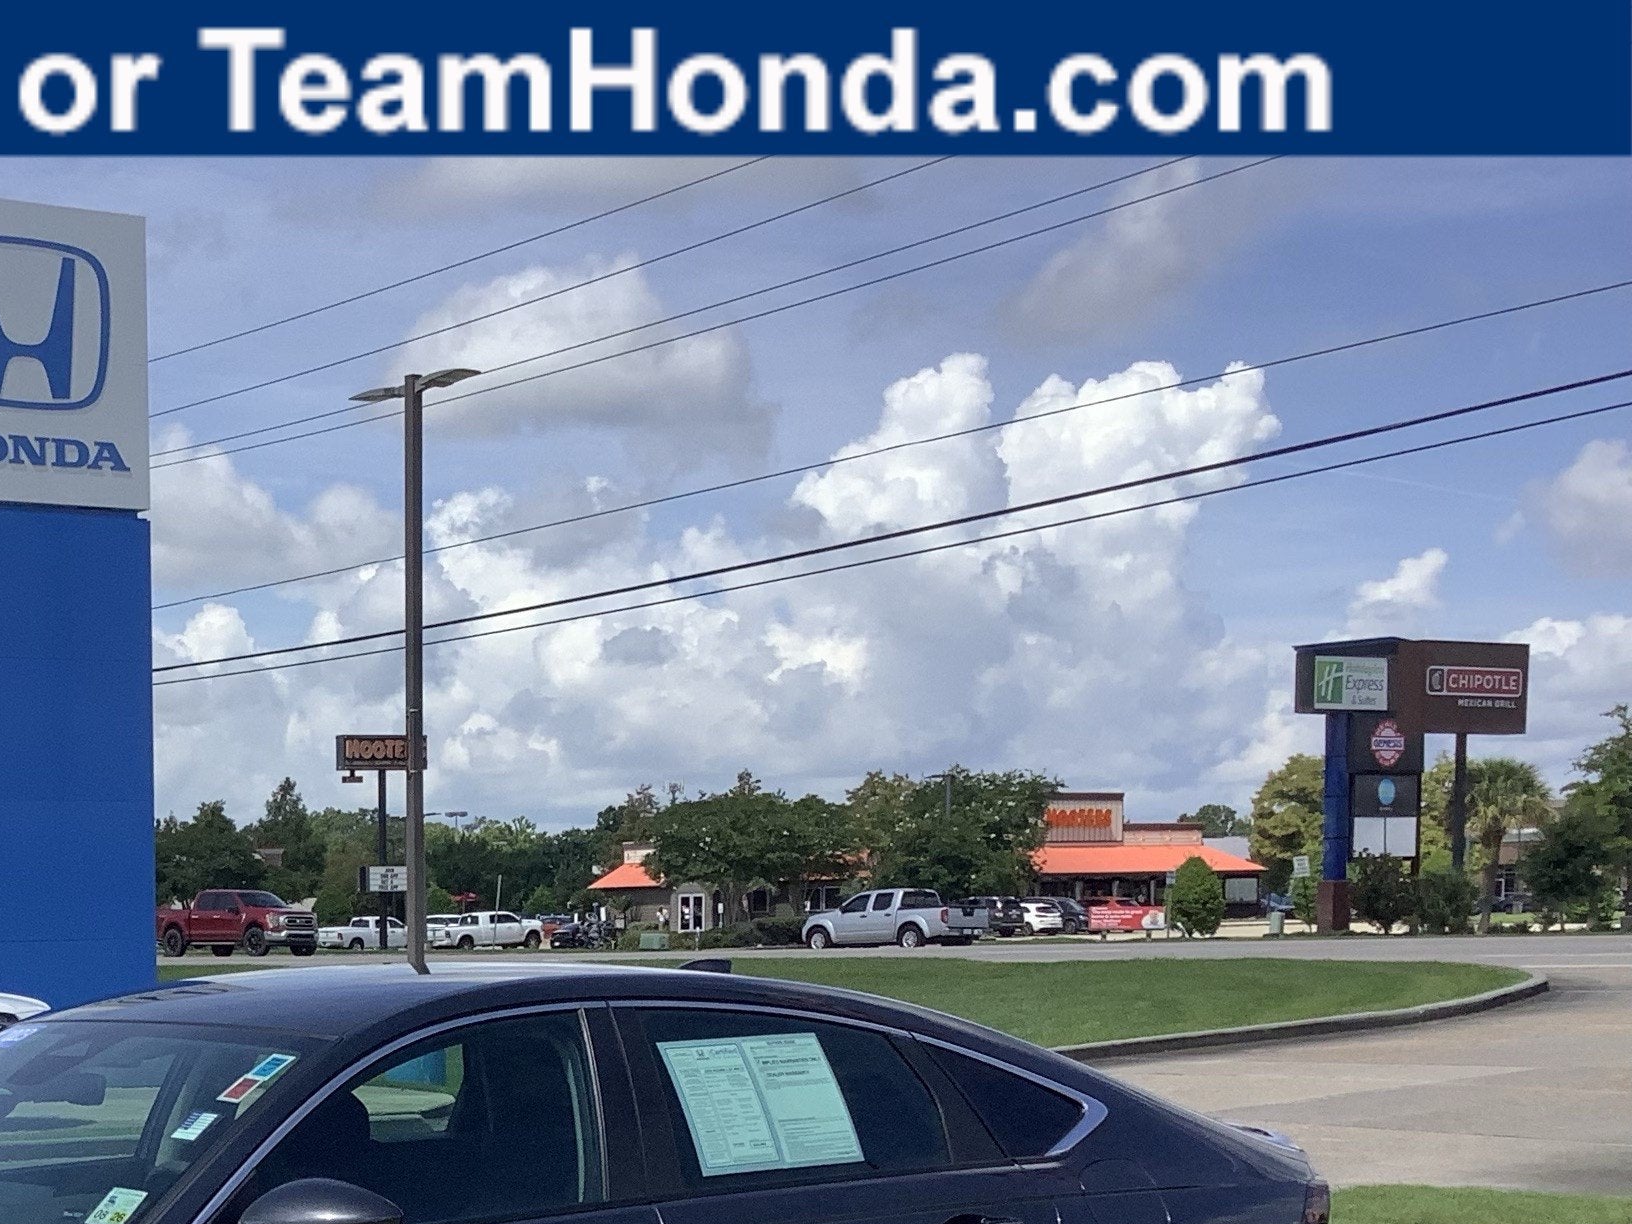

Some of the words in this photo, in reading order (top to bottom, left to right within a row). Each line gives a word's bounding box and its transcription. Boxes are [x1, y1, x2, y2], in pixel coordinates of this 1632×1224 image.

[1345, 675, 1384, 693] Express
[1449, 674, 1518, 690] CHIPOTLE
[1458, 699, 1493, 708] MEXICAN
[345, 739, 408, 760] HOOTE
